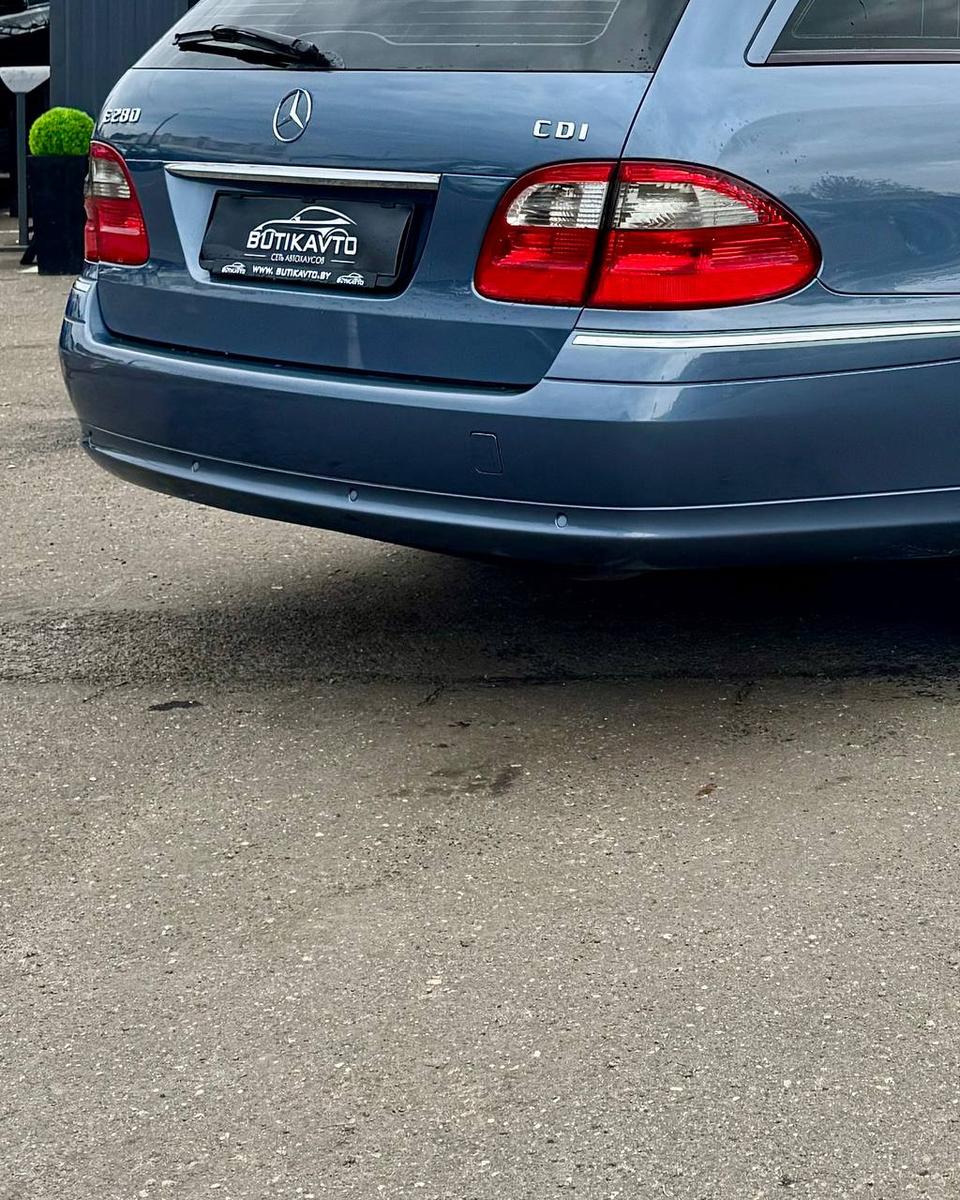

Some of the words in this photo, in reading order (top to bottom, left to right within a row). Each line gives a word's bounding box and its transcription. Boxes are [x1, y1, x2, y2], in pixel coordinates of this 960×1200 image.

[103, 108, 142, 124] E280
[533, 119, 589, 140] CDI
[246, 230, 358, 256] BUTIKAVTO
[270, 253, 284, 262] СЕТЬ
[285, 254, 326, 265] АВТОХАУСОВ
[252, 265, 274, 275] WWW.
[275, 267, 332, 280] BUTIKAVTO.BY
